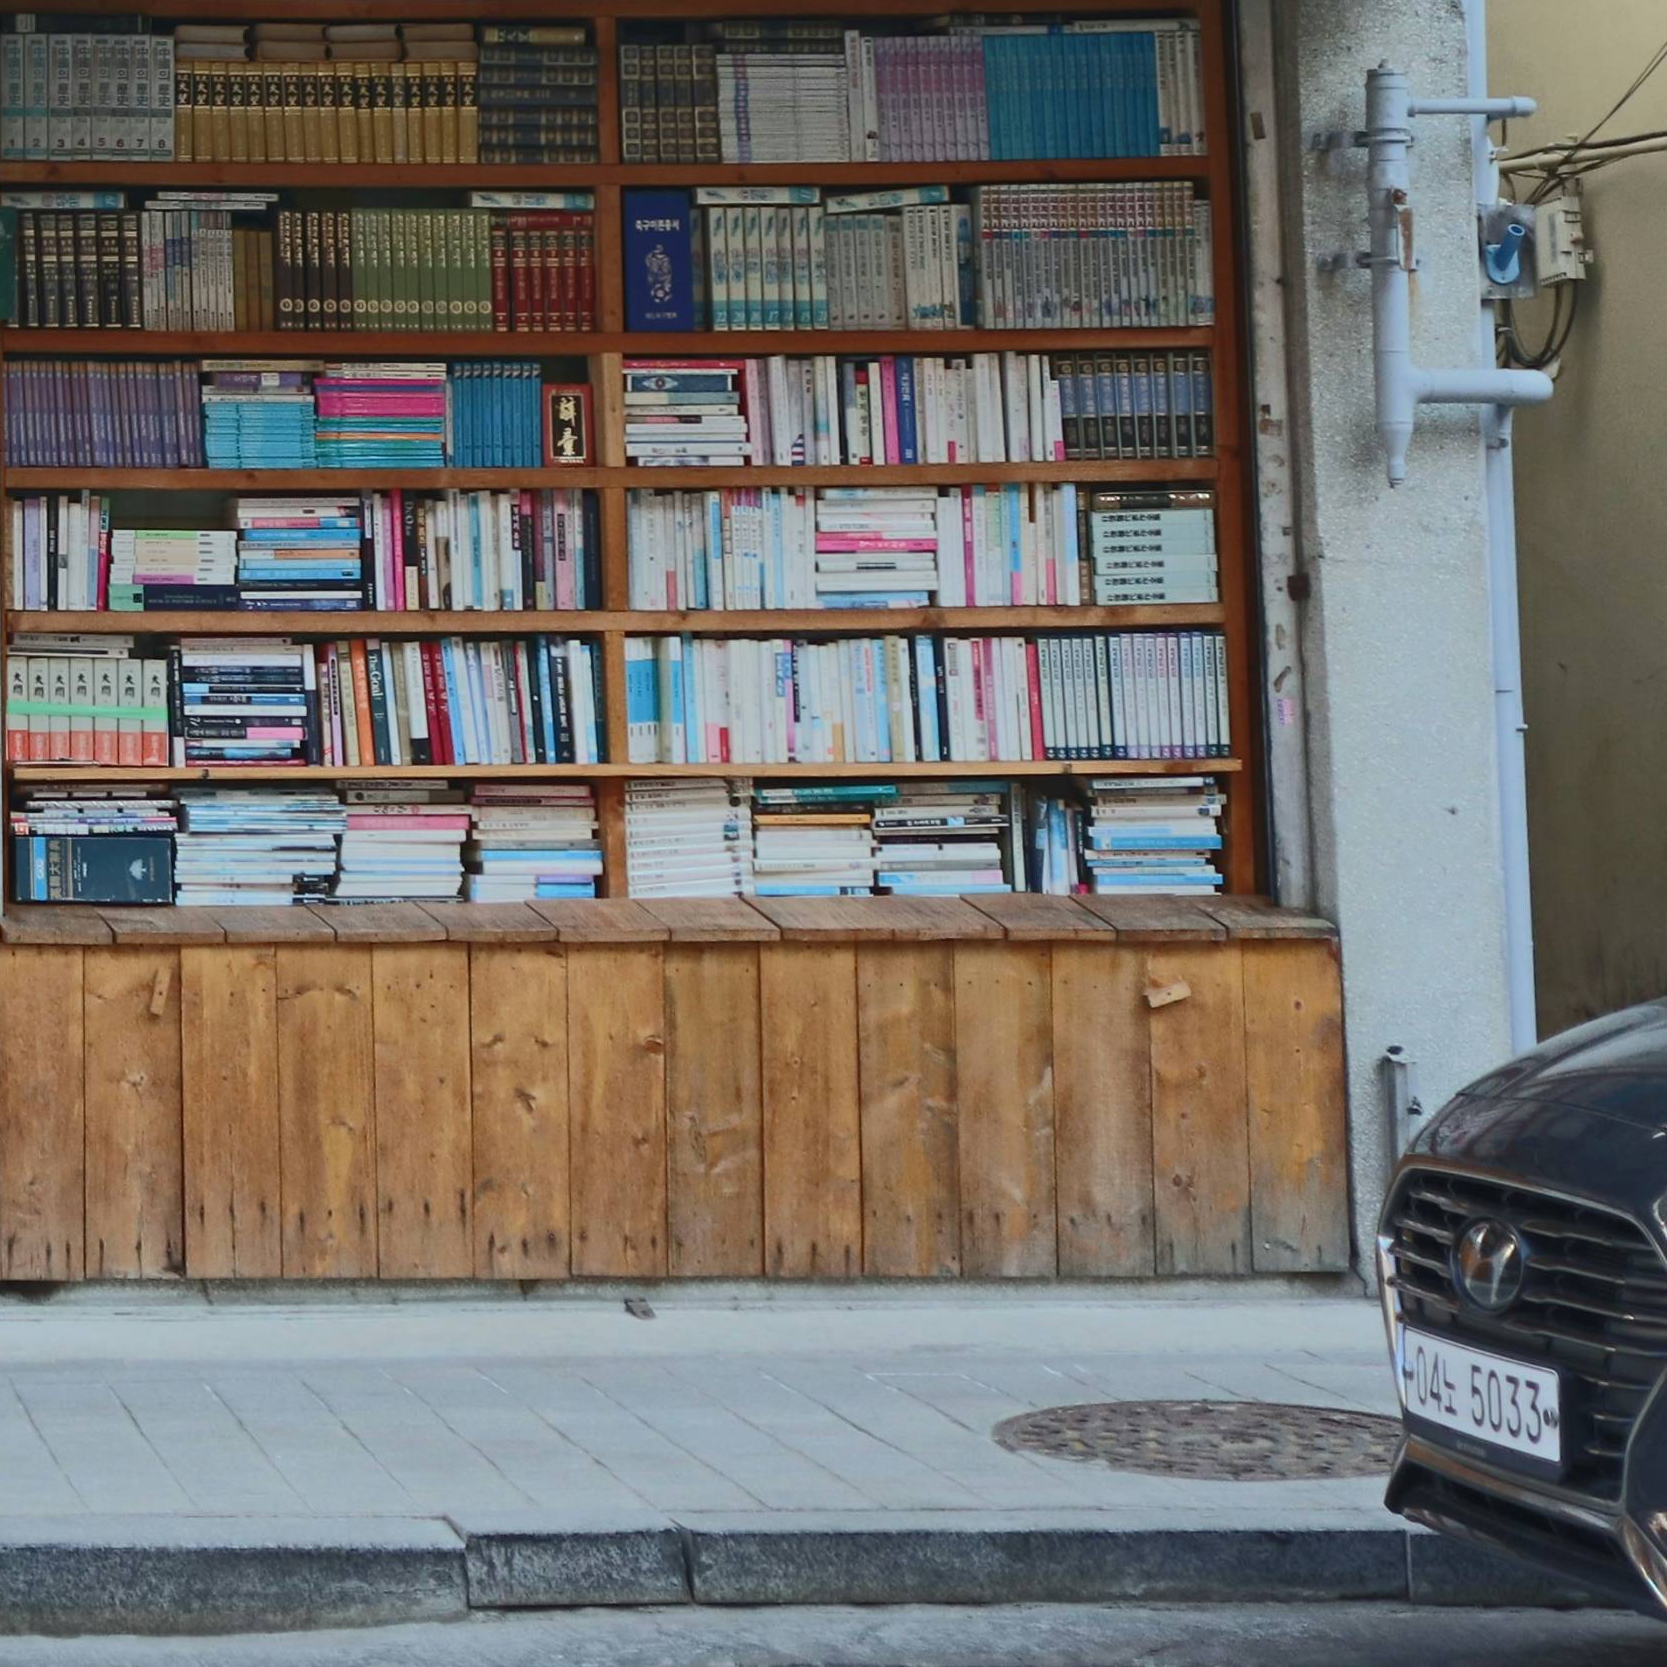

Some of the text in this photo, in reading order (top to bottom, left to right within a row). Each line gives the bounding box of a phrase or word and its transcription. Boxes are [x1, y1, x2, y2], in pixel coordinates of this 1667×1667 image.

[9, 138, 15, 148] 1
[33, 138, 41, 148] 2
[57, 138, 65, 148] 3
[77, 138, 85, 148] 4
[98, 138, 106, 148] 5
[116, 138, 124, 148] 6
[136, 138, 144, 148] 7
[158, 138, 165, 148] 8
[1415, 1346, 1543, 1445] 04노 5033
